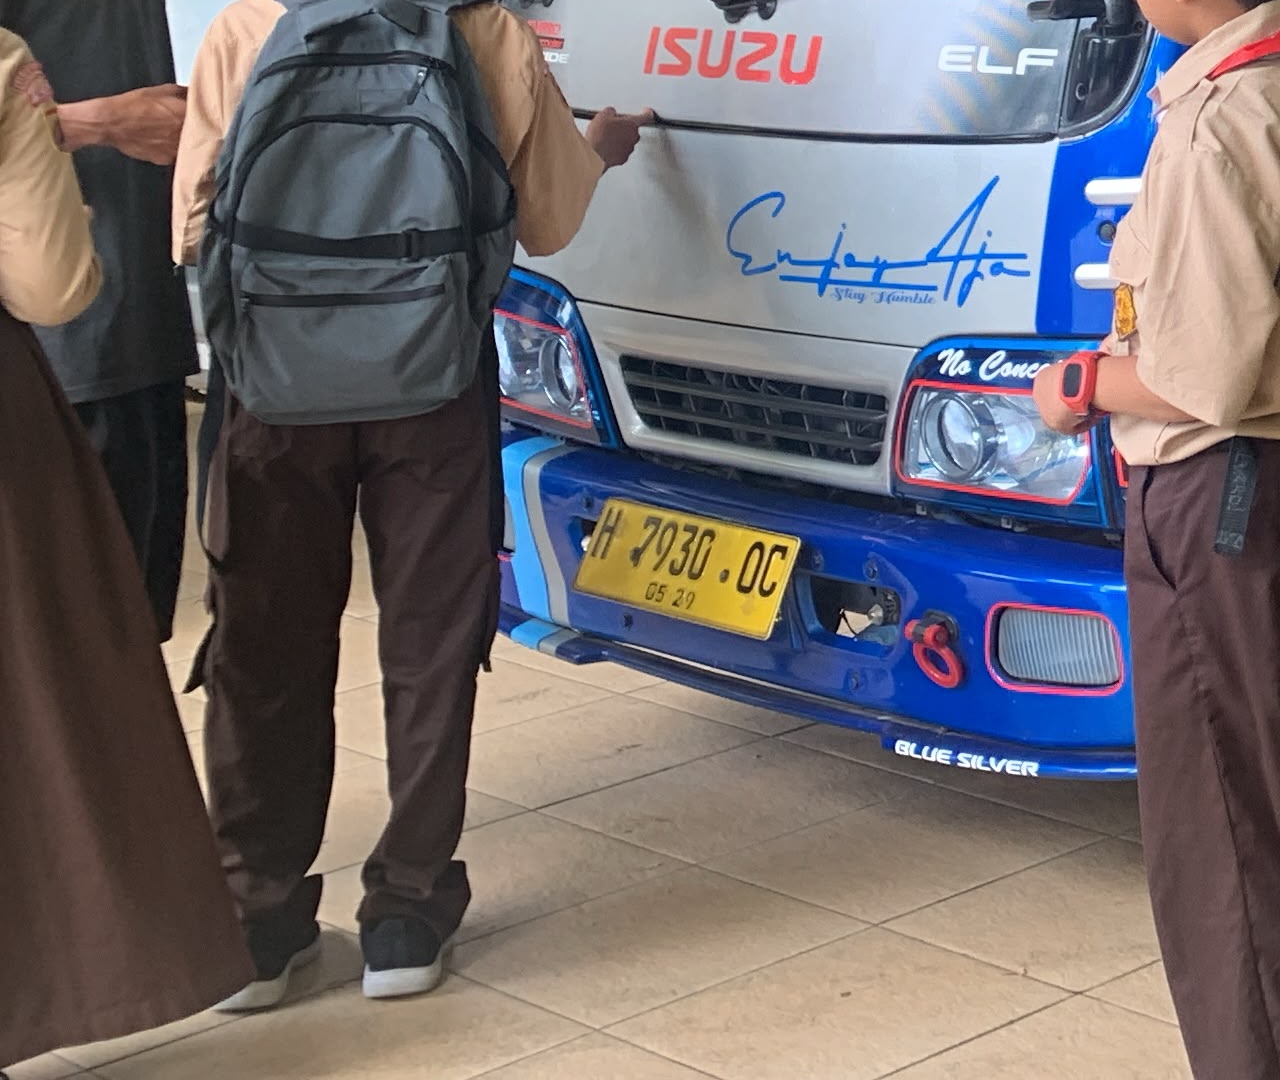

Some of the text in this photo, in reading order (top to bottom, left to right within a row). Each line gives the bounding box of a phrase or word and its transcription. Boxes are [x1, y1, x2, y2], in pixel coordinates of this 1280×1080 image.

[643, 26, 823, 85] ISUZU
[938, 44, 1059, 76] ELF
[727, 175, 1031, 308] Enjoy Aja
[938, 348, 972, 377] No
[591, 508, 789, 597] H 7930 OC
[894, 739, 1040, 778] BLUE SILVER
